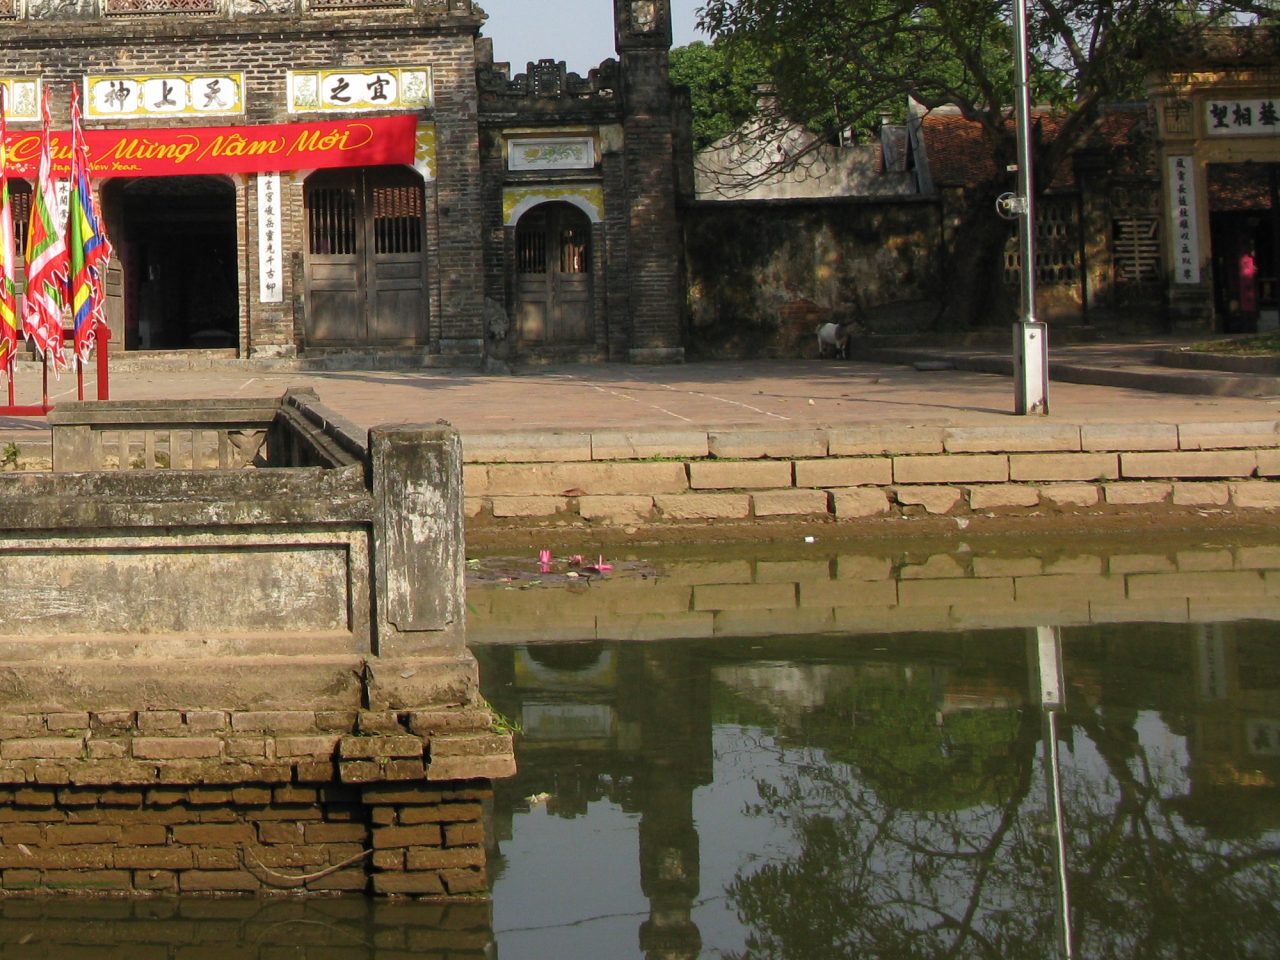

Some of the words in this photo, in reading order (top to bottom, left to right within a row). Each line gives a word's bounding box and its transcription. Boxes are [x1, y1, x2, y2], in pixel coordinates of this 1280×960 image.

[94, 133, 200, 164] Mừng
[195, 132, 286, 162] Năm
[286, 123, 374, 157] Mới
